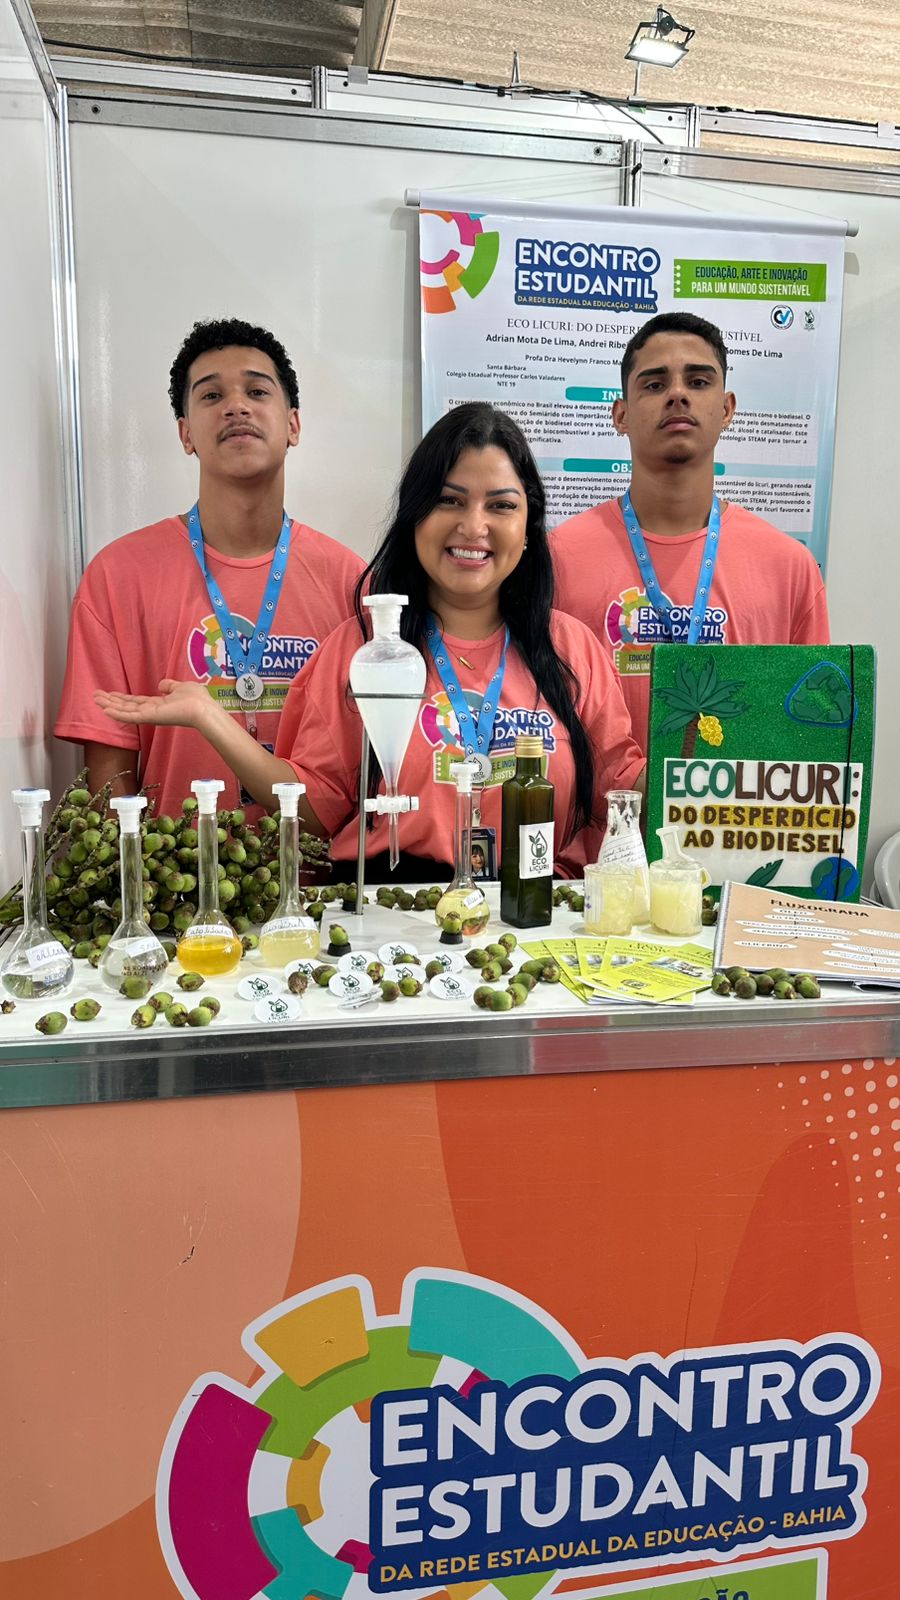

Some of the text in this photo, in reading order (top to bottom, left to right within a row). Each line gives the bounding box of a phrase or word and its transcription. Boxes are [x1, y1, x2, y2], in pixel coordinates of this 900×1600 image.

[518, 242, 657, 272] ENCONTRO
[518, 270, 655, 298] ESTUDANTIL
[696, 266, 808, 282] EDUCAÇÃO, ARTE E INOVAÇÃO
[692, 282, 810, 296] PARA UM MUNDO SUSTENTÁVEL
[548, 298, 581, 306] ESTADUAL
[593, 300, 630, 311] EDUCAÇÃO
[507, 318, 763, 342] ECO LICURI: DO DESPER USTÍVEL
[486, 334, 514, 344] Adrian
[517, 336, 538, 344] Mota
[541, 337, 552, 345] De
[554, 338, 577, 347] Lima,
[578, 339, 606, 348] Andrei
[608, 340, 628, 349] Ribe
[764, 350, 782, 358] Lima
[640, 608, 724, 624] ENONRO
[640, 623, 722, 637] ESTUDATIL
[669, 805, 856, 829] DO DESPERDÍCIO
[683, 830, 844, 853] AO BIODIESEL
[771, 900, 870, 918] FLUXOGRAMA
[382, 1354, 861, 1467] ENCONTRO
[381, 1434, 848, 1548] ESTUDANTIL
[380, 1561, 414, 1584] DA
[420, 1554, 480, 1577] REDE
[486, 1538, 602, 1570] ESTADUAL
[608, 1534, 639, 1554] DA
[644, 1514, 765, 1546] EDUCAÇÃO
[782, 1505, 846, 1530] BAHIA
